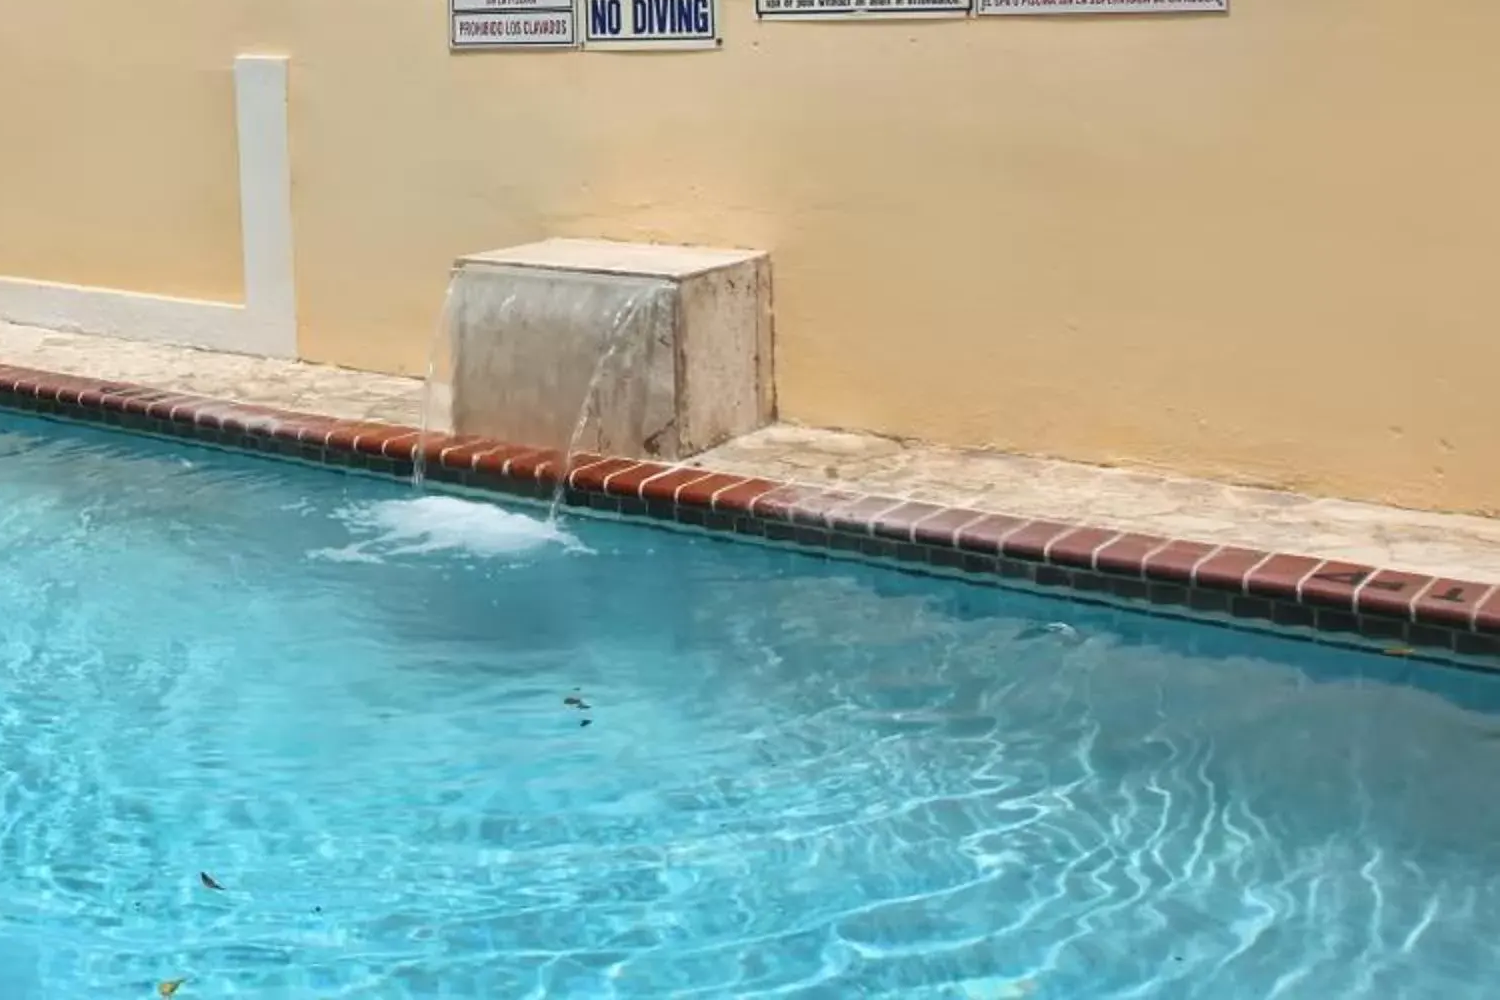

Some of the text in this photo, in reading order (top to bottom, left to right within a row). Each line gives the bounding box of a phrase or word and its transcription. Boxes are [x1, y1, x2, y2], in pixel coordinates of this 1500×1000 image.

[766, 0, 781, 9] spa
[784, 0, 793, 8] or
[506, 21, 521, 36] LOS
[524, 20, 567, 35] CLAVADOS
